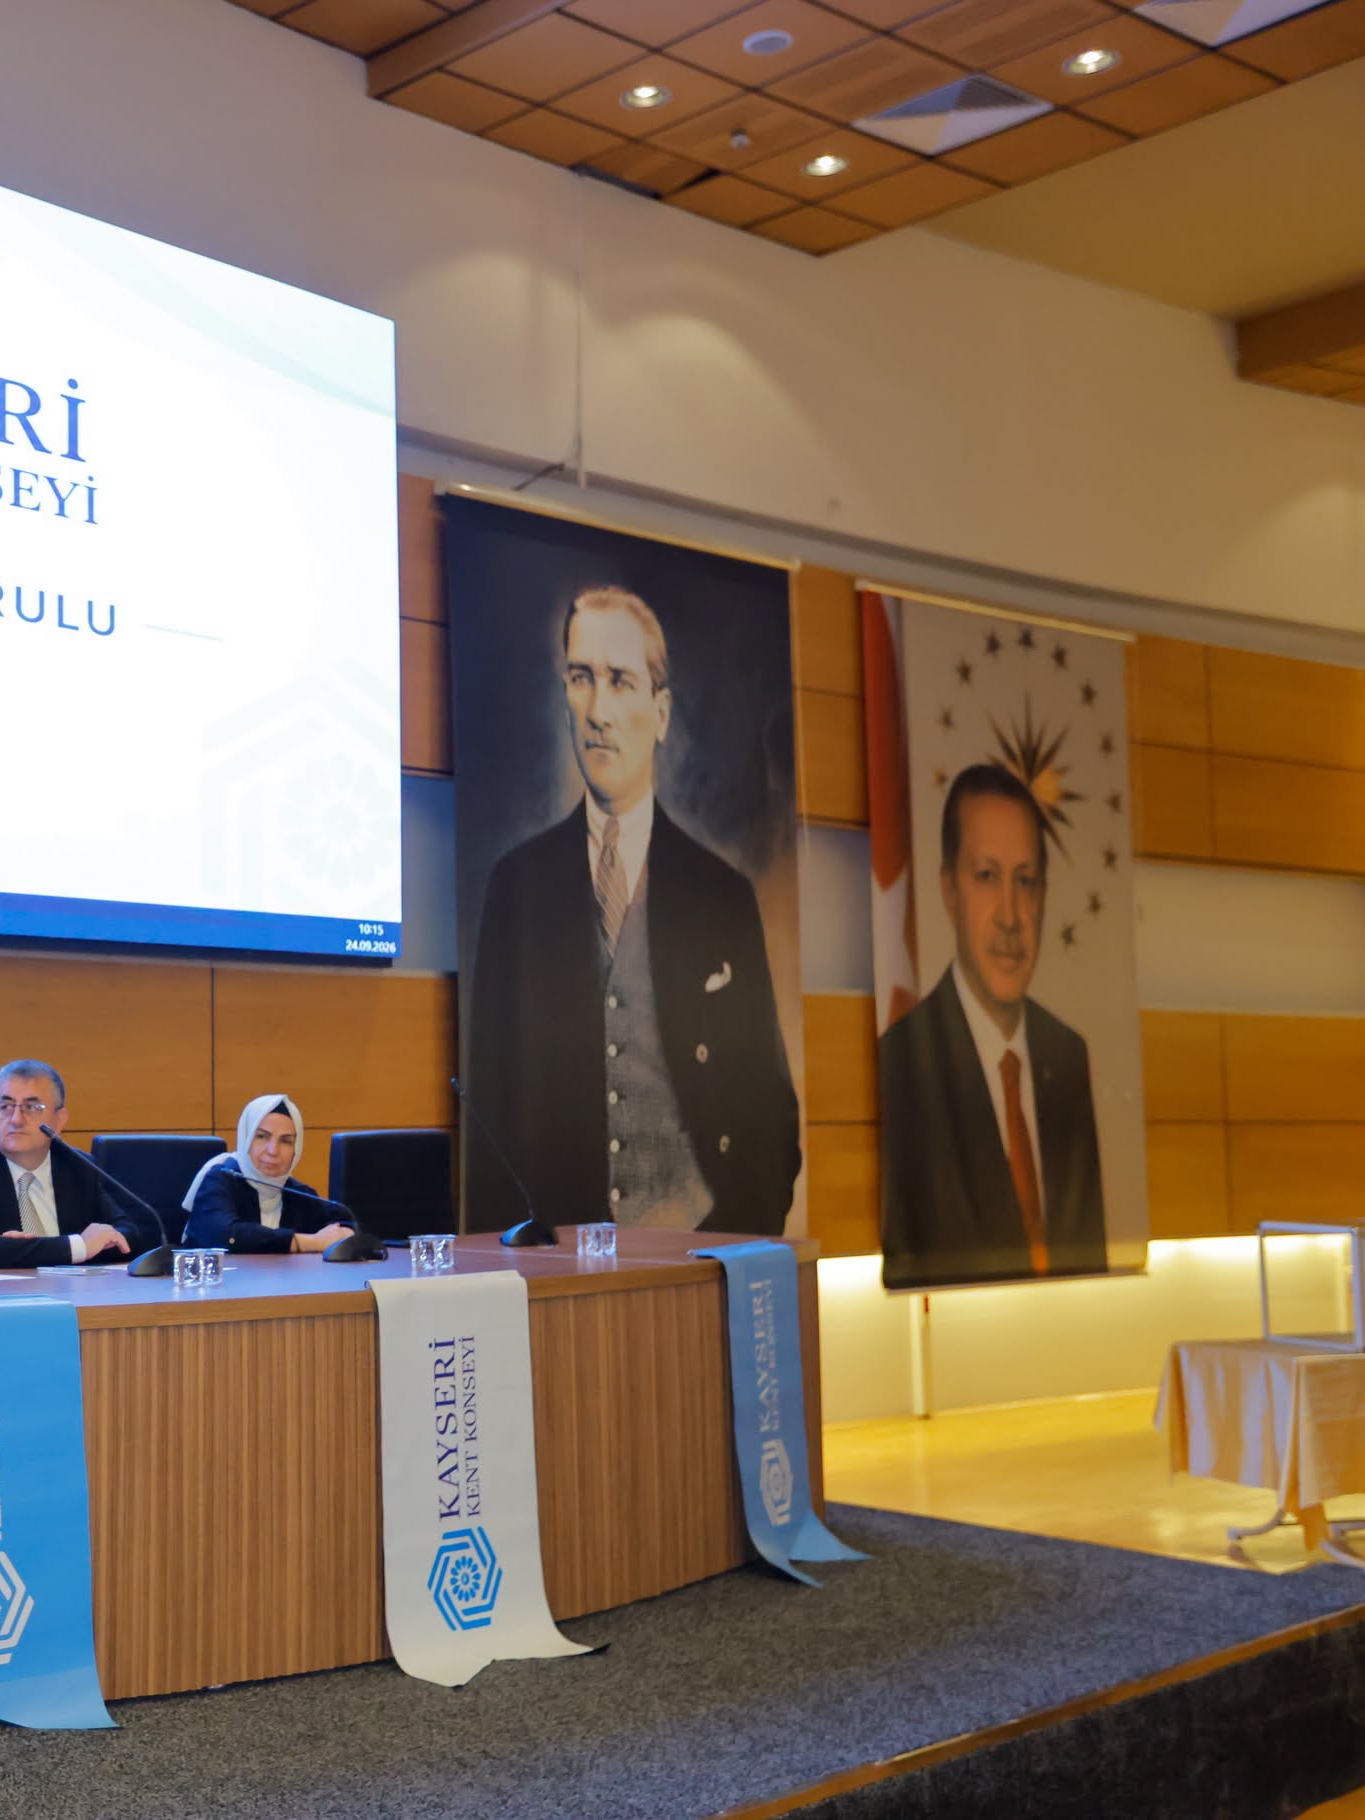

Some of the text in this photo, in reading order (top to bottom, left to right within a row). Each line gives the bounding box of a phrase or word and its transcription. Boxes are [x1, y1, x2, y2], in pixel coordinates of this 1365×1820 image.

[345, 939, 397, 954] 24.09.2026
[358, 923, 384, 936] 10:15
[428, 1336, 461, 1523] KAYSERİ
[459, 1336, 481, 1518] KENT KONSEYİ
